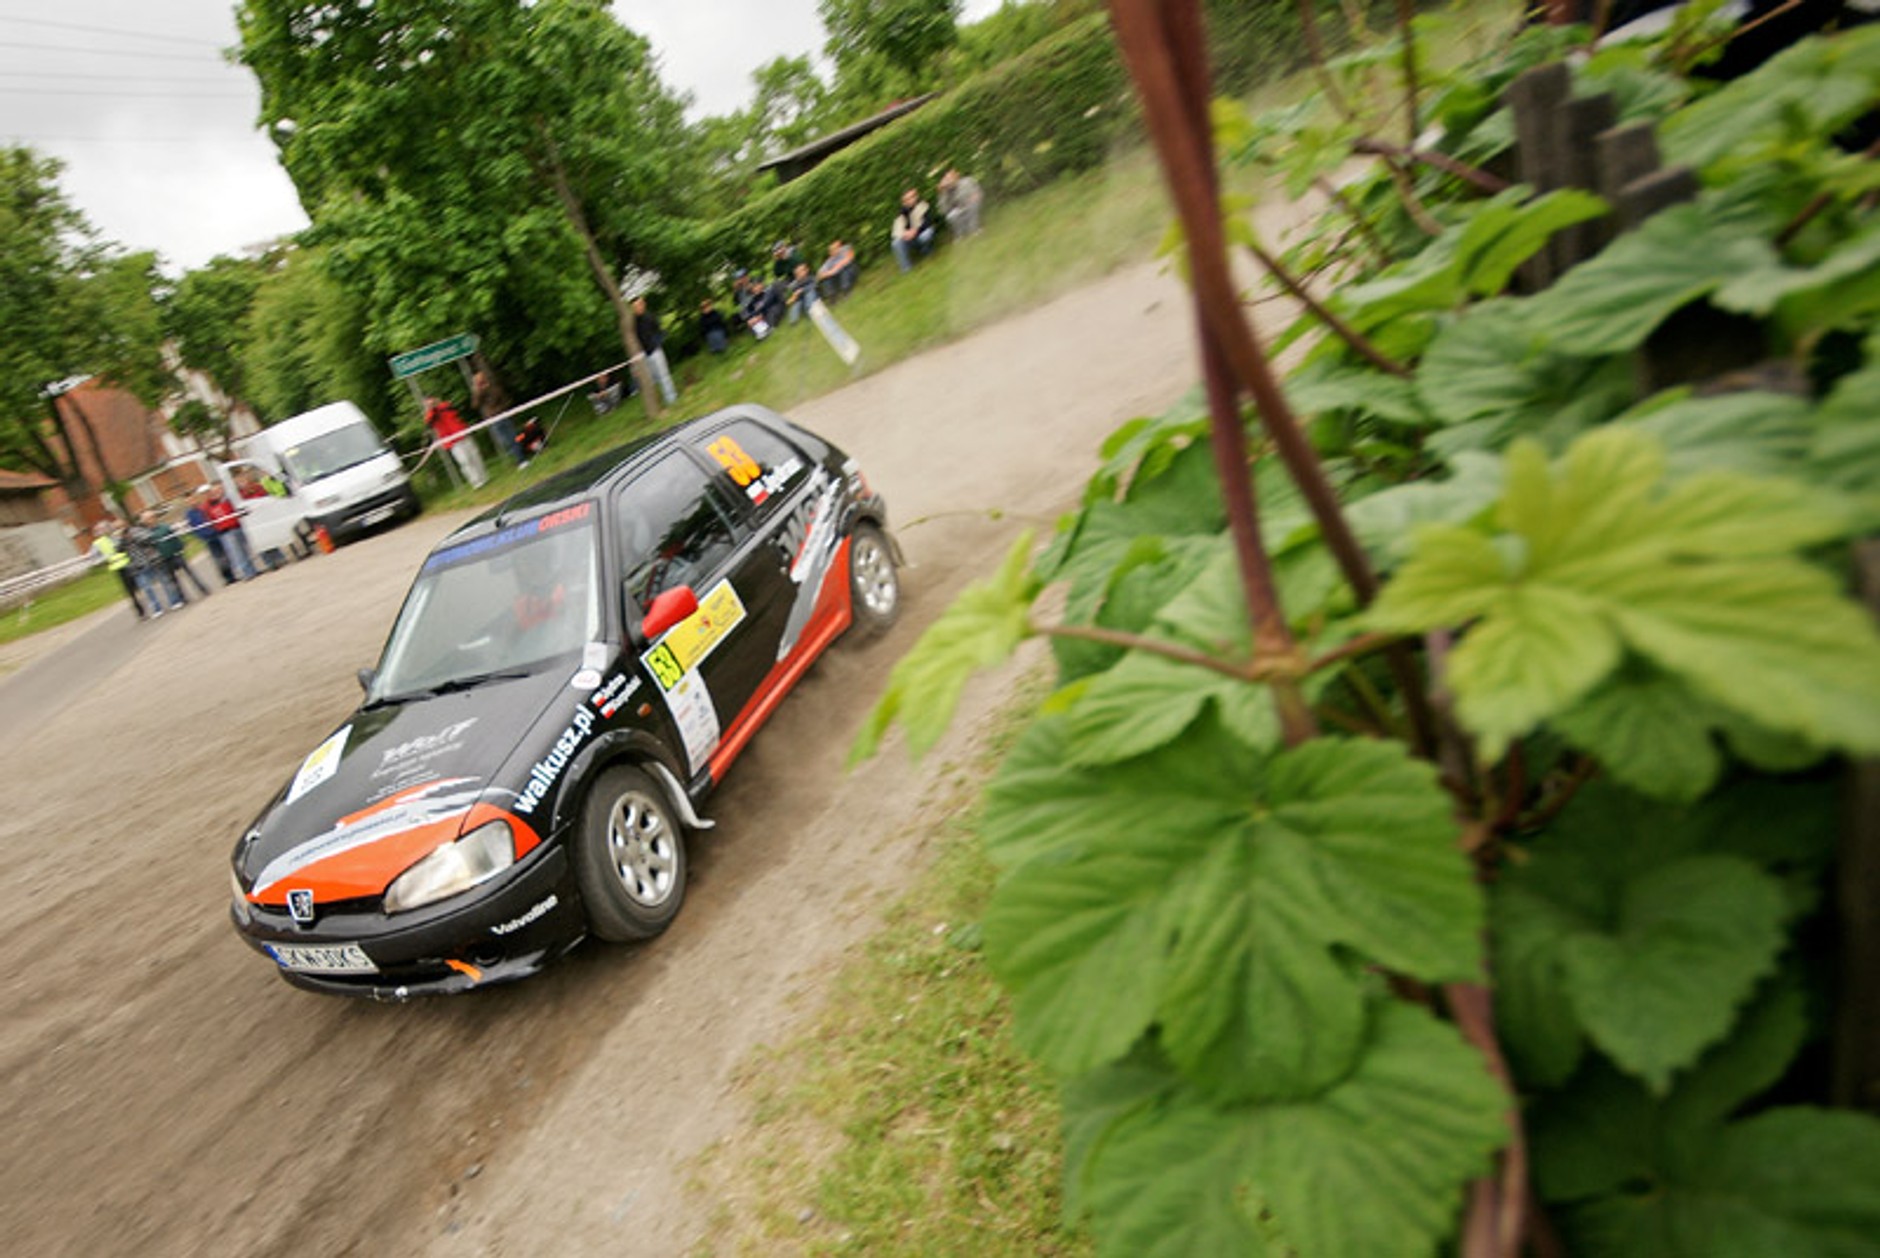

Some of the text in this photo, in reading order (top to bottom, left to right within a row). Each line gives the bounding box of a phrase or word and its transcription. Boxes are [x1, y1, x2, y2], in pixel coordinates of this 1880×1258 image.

[705, 436, 762, 487] 53
[646, 644, 683, 689] 53
[514, 702, 596, 813] walkusz.pl
[490, 894, 559, 936] Valvoline
